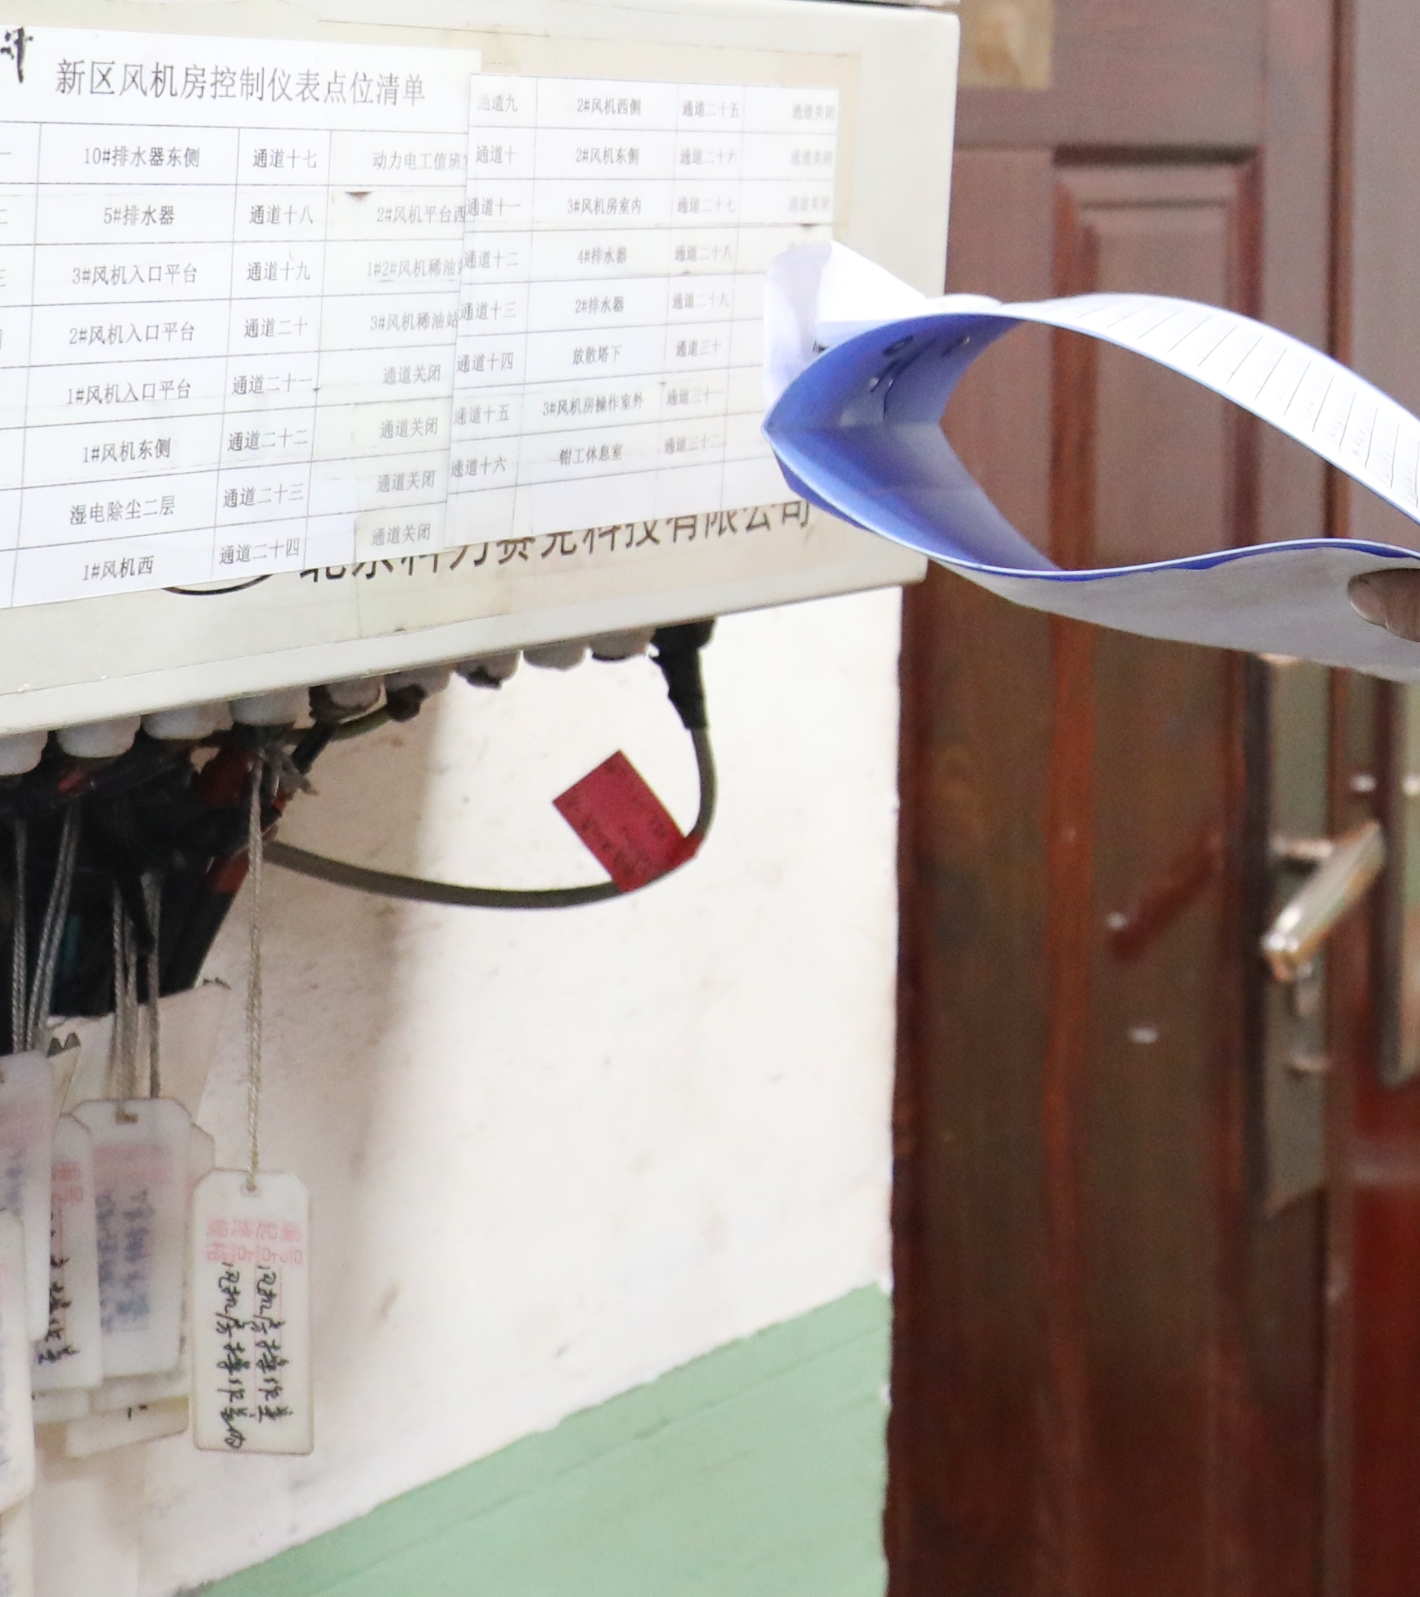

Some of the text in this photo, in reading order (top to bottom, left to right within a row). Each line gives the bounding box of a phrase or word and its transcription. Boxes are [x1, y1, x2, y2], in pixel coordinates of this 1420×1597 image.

[54, 57, 426, 107] 新区风机房控制仪表点位清单
[477, 92, 518, 113] 通道九
[576, 97, 642, 117] 2#风机西侧
[681, 99, 740, 118] 通道二十五
[82, 146, 201, 170] 10#排水器东侧
[252, 147, 318, 171] 通道十七
[475, 144, 517, 164] 通道十
[575, 145, 641, 165] 2#风机东侧
[679, 147, 738, 165] 通道二十六
[102, 206, 176, 227] 5#排水器
[249, 204, 315, 227] 通道十八
[466, 197, 522, 217] 通道十一
[567, 197, 642, 215] 3#风机房室内
[676, 196, 736, 214] 通道二十七
[463, 244, 733, 270] 通道十二 4#排水器 通道二十八
[71, 263, 198, 287] 3#风机入口平台
[246, 260, 312, 283] 通道十九
[459, 291, 730, 320] 通道十三 2#排水器 通道二十九
[68, 321, 196, 347] 2#风机入口平台
[243, 316, 309, 340] 通道二十
[456, 338, 722, 373] 通道十四 放散塔下 通道三十
[65, 363, 442, 406] 1#风机入口平台 通道二十一 通道关闭
[453, 403, 510, 424] 通道十五
[542, 392, 644, 419] 3#风机房操作室外
[82, 417, 439, 464] 1#风机东侧 通道二十二 通道关闭
[450, 454, 507, 478] 通道十六
[68, 470, 436, 526] 湿电除尘二层 通道二十三 通道关闭
[82, 523, 432, 582] 1#风机西 通道二十四 通道关闭
